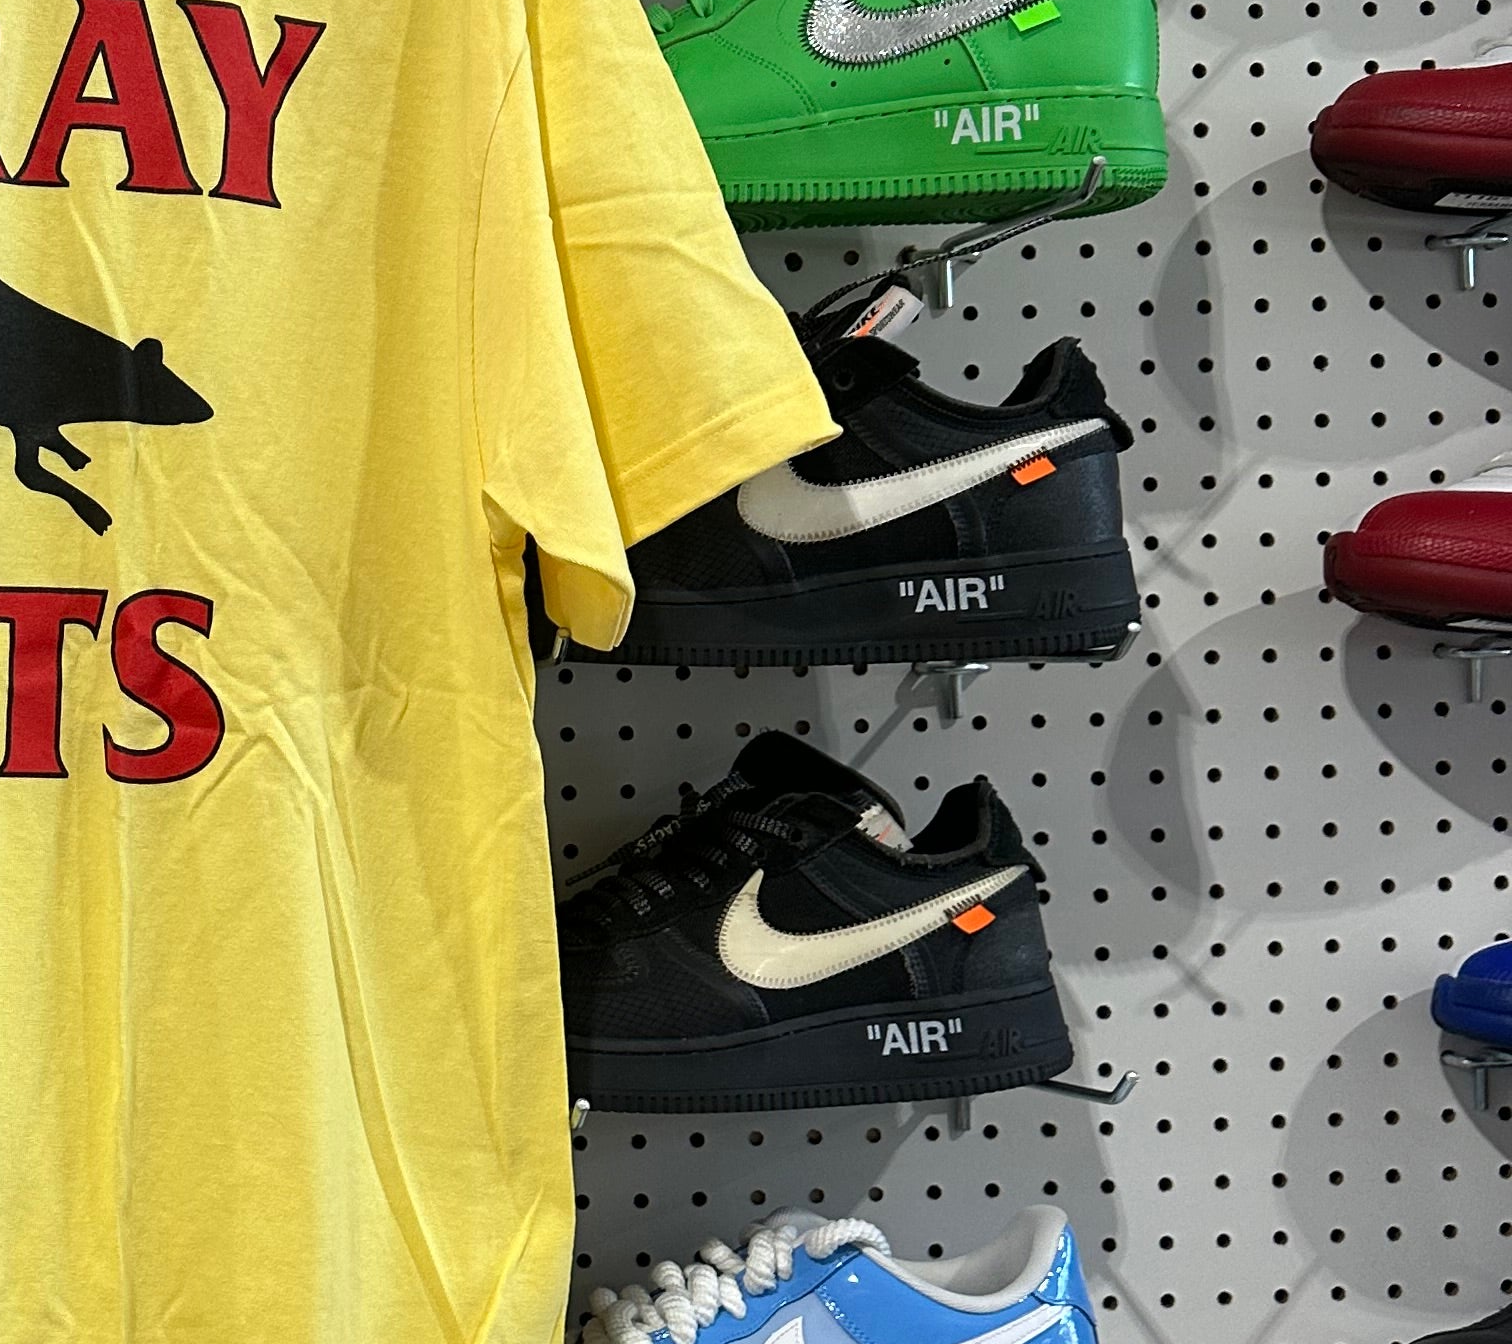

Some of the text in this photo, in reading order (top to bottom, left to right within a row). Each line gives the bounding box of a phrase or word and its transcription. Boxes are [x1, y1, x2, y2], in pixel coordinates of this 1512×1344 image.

[933, 102, 1040, 146] "AIR"
[1048, 124, 1101, 156] AIR
[899, 574, 1006, 614] "AIR"
[865, 1017, 963, 1056] "AIR"
